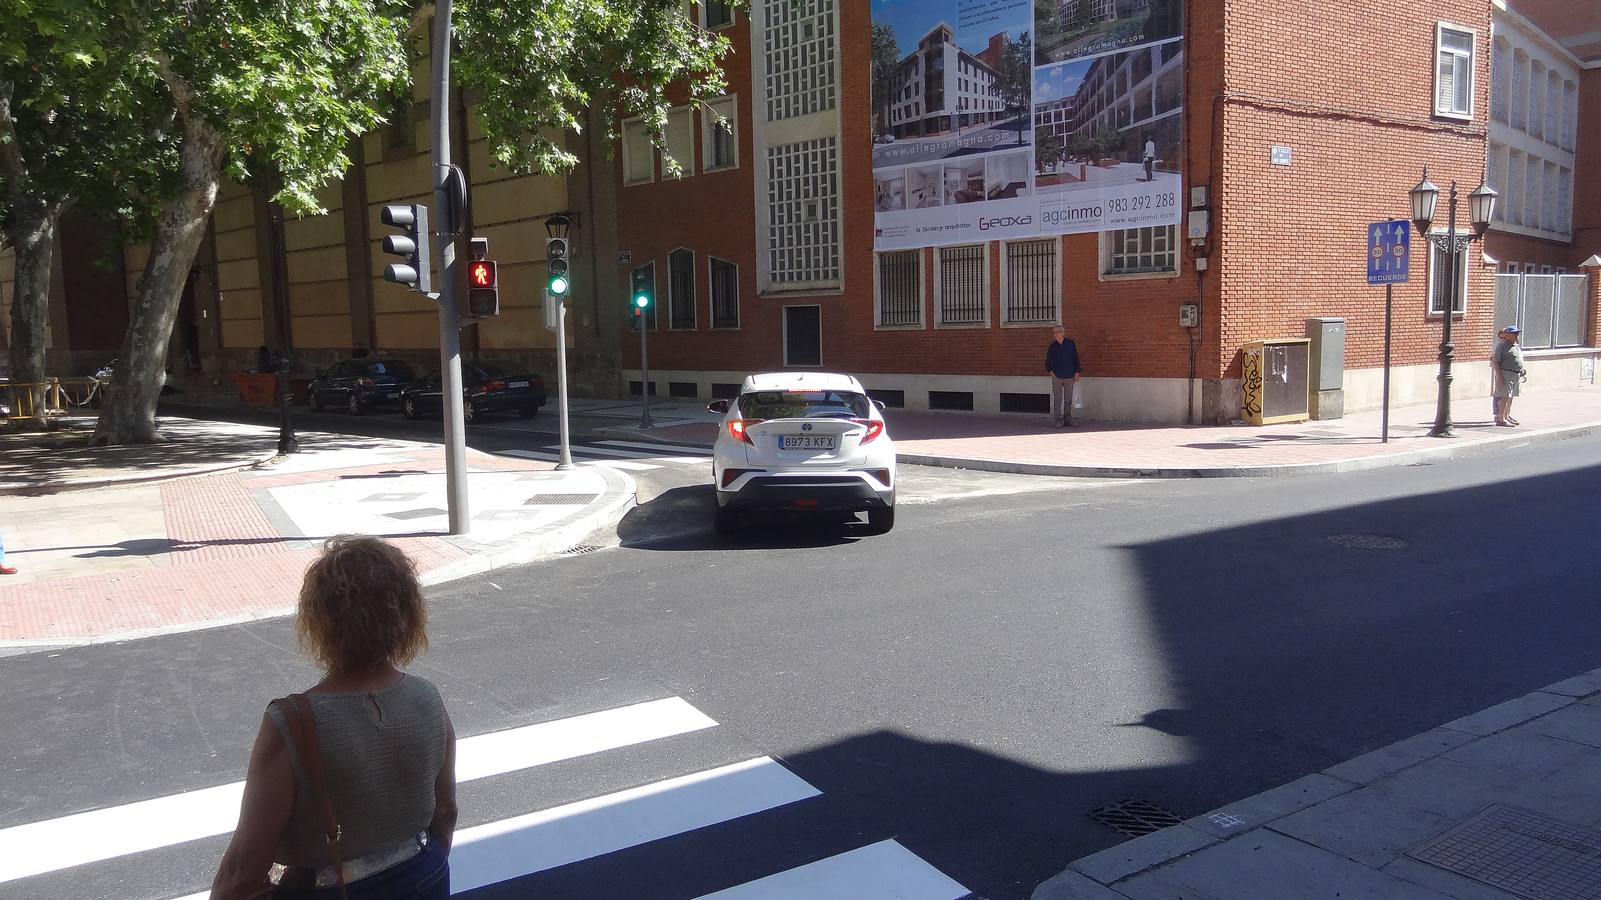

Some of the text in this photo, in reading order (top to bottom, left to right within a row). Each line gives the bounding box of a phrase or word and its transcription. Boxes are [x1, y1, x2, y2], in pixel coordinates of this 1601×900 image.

[884, 132, 1010, 157] www.allegramagna.com
[1108, 192, 1175, 214] 983 292 288
[1042, 206, 1102, 225] agcinmo
[1109, 212, 1176, 224] www.agcinmo.com
[1373, 248, 1382, 256] 50
[1367, 273, 1407, 282] RECUERDE
[785, 437, 833, 447] 8973 KFX
